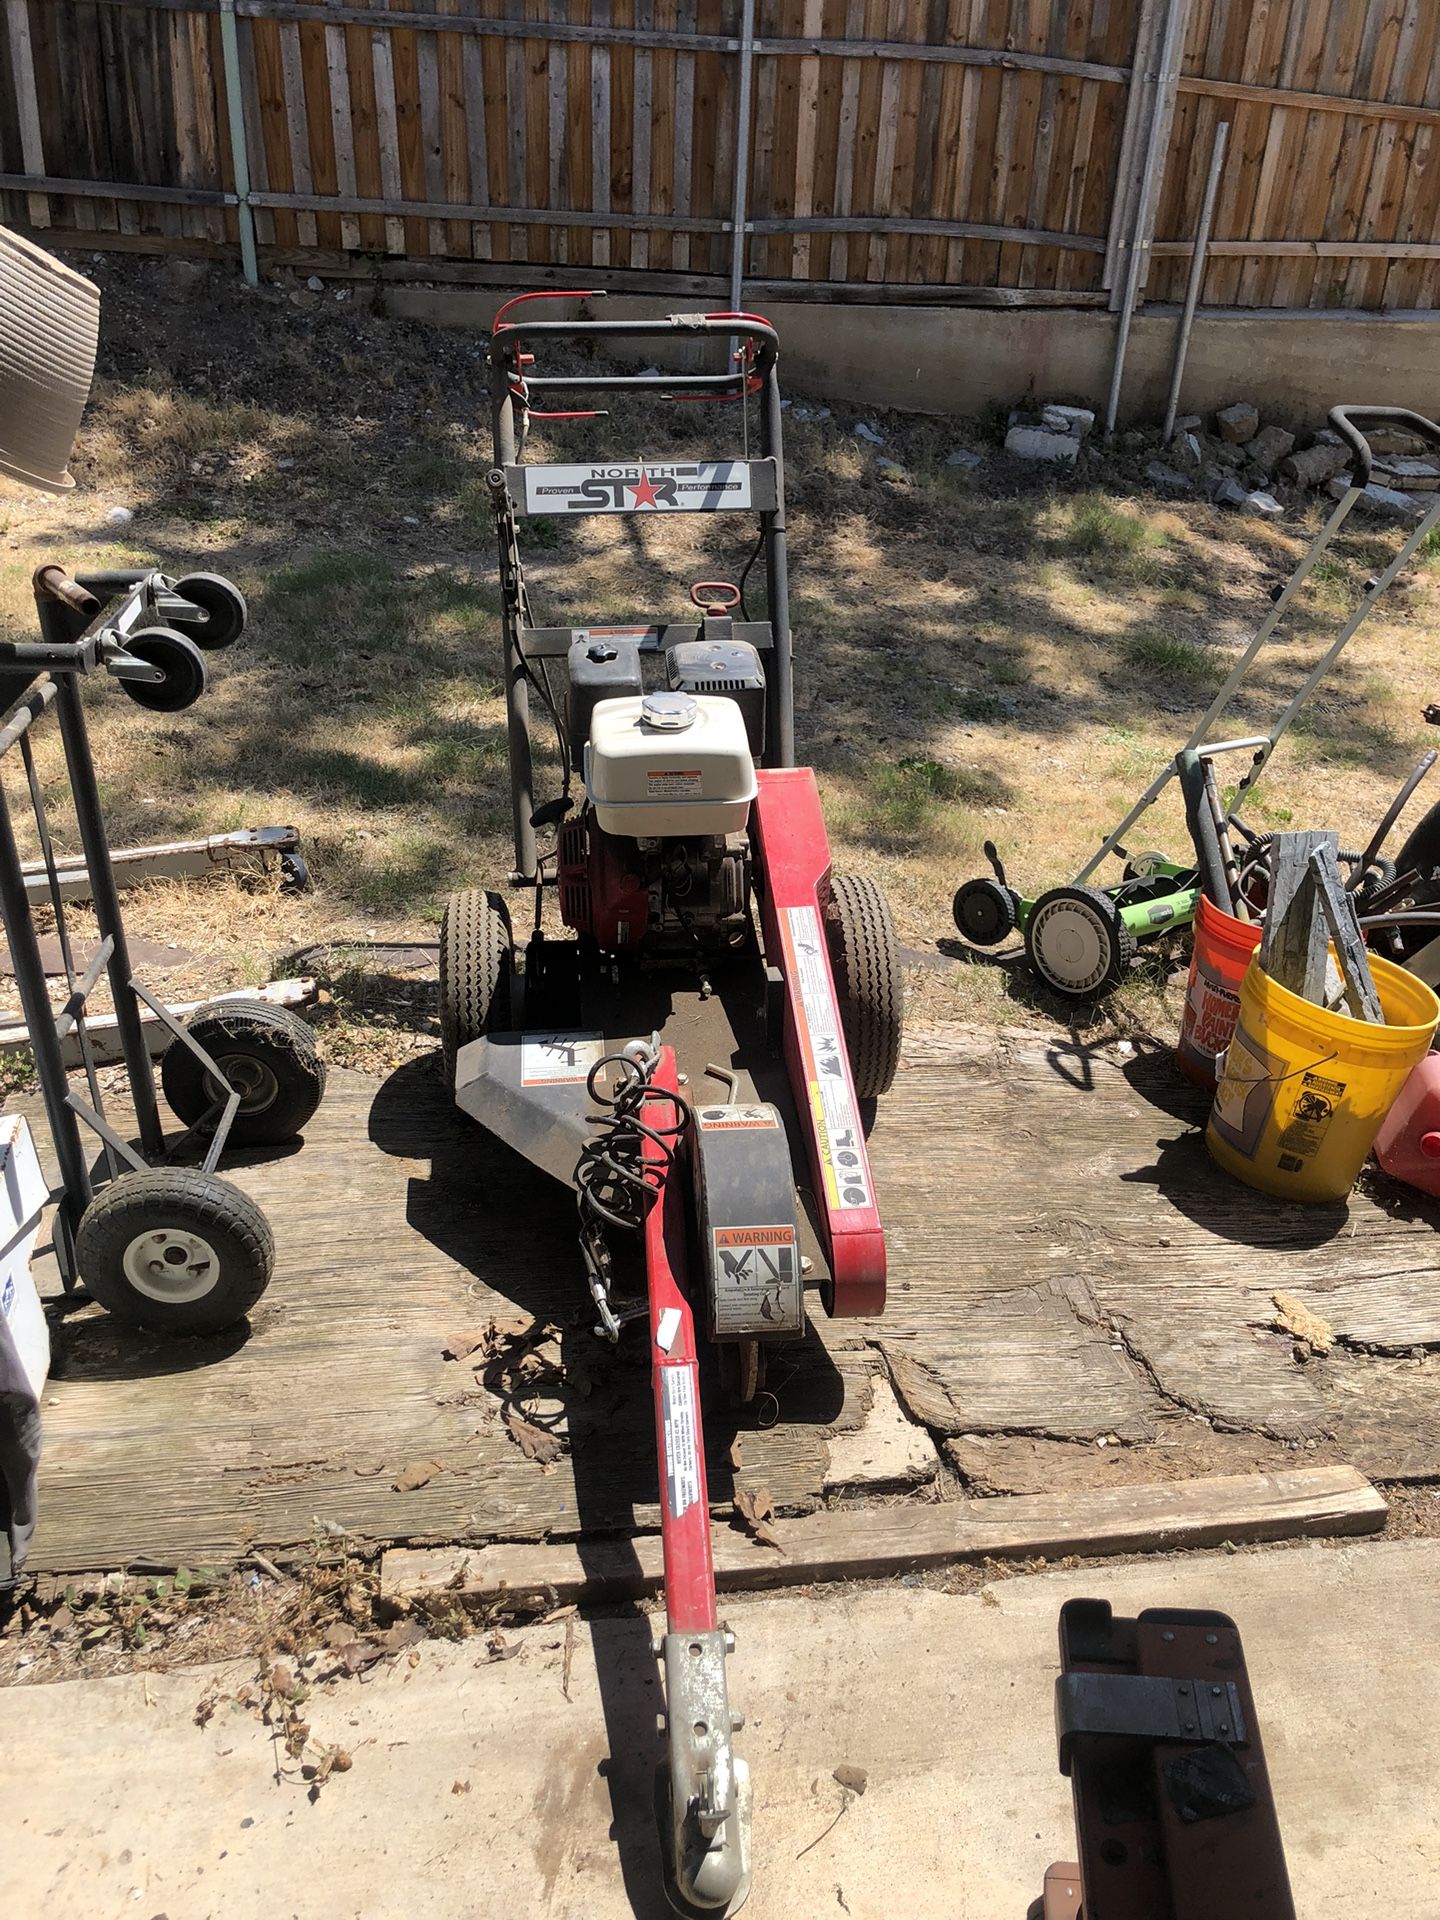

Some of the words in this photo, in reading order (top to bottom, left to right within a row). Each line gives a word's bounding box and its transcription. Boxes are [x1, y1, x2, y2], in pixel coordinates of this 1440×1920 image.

[591, 467, 676, 479] NORTH
[541, 486, 575, 495] Proven
[681, 482, 739, 491] Performance
[703, 1121, 761, 1129] WARNING
[817, 1119, 830, 1155] CAUTION
[732, 1230, 792, 1243] WARNING
